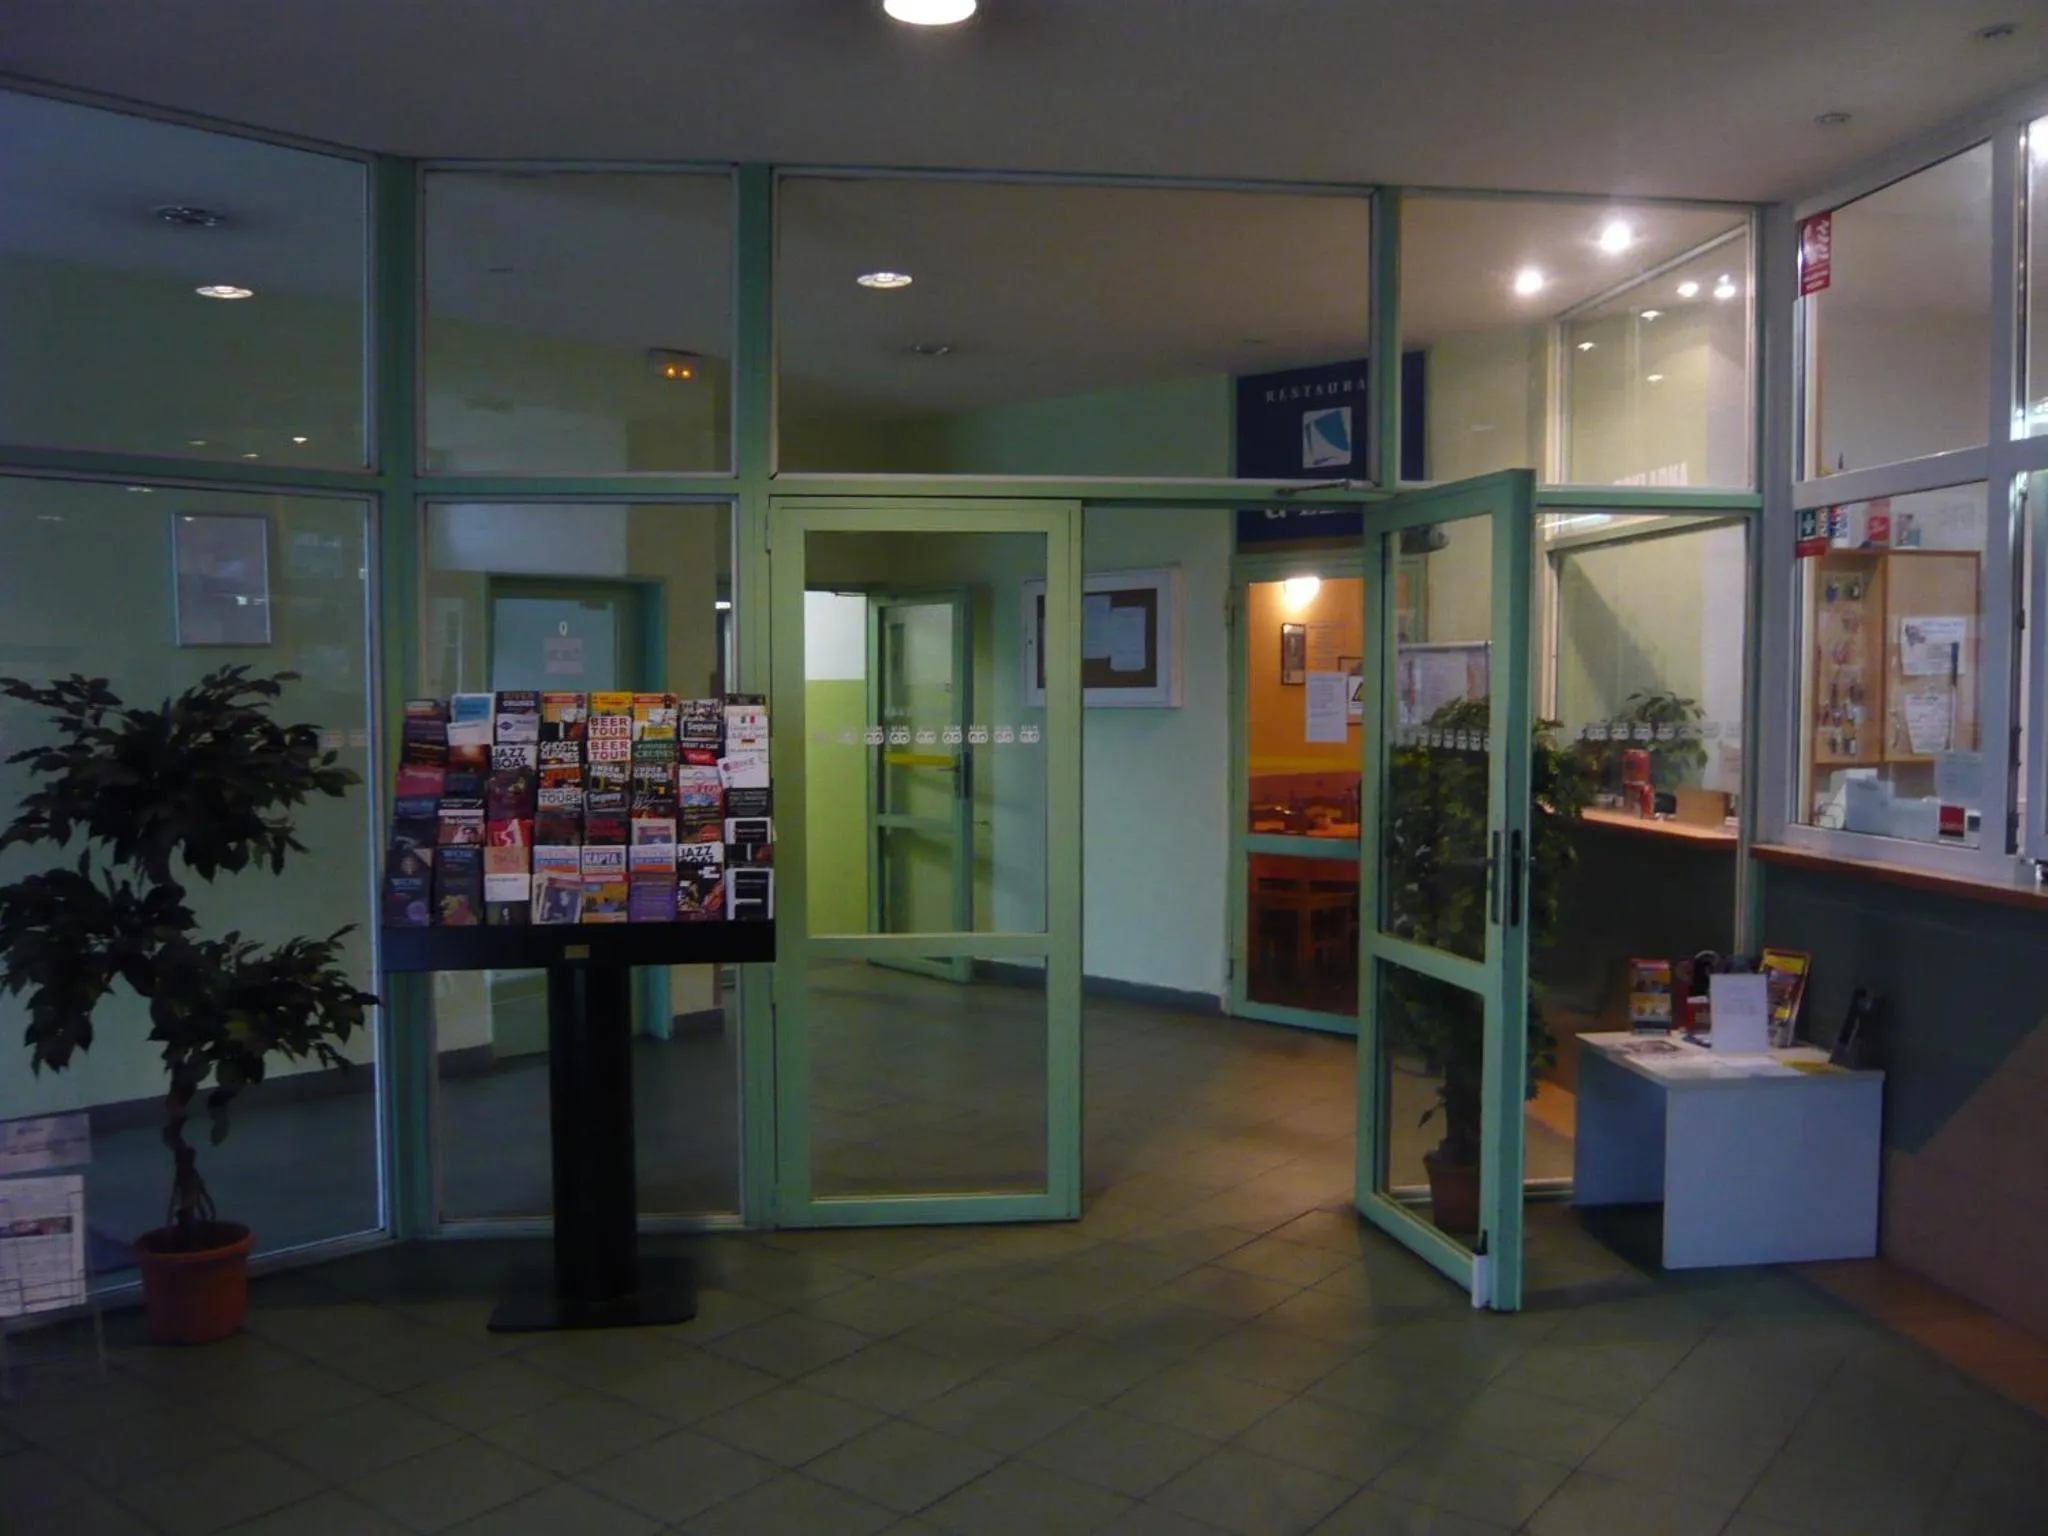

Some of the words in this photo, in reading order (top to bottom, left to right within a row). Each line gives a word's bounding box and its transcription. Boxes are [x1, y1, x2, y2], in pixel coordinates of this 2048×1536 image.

[1266, 378, 1366, 403] RESTAURA
[591, 717, 628, 727] BEER
[591, 727, 628, 736] TOUR
[591, 741, 628, 751] BEER
[492, 747, 526, 758] JAZZ
[591, 751, 628, 760] TOUR
[492, 758, 528, 769] BOAT
[540, 794, 581, 803] TOURS
[680, 845, 713, 857] JAZZ
